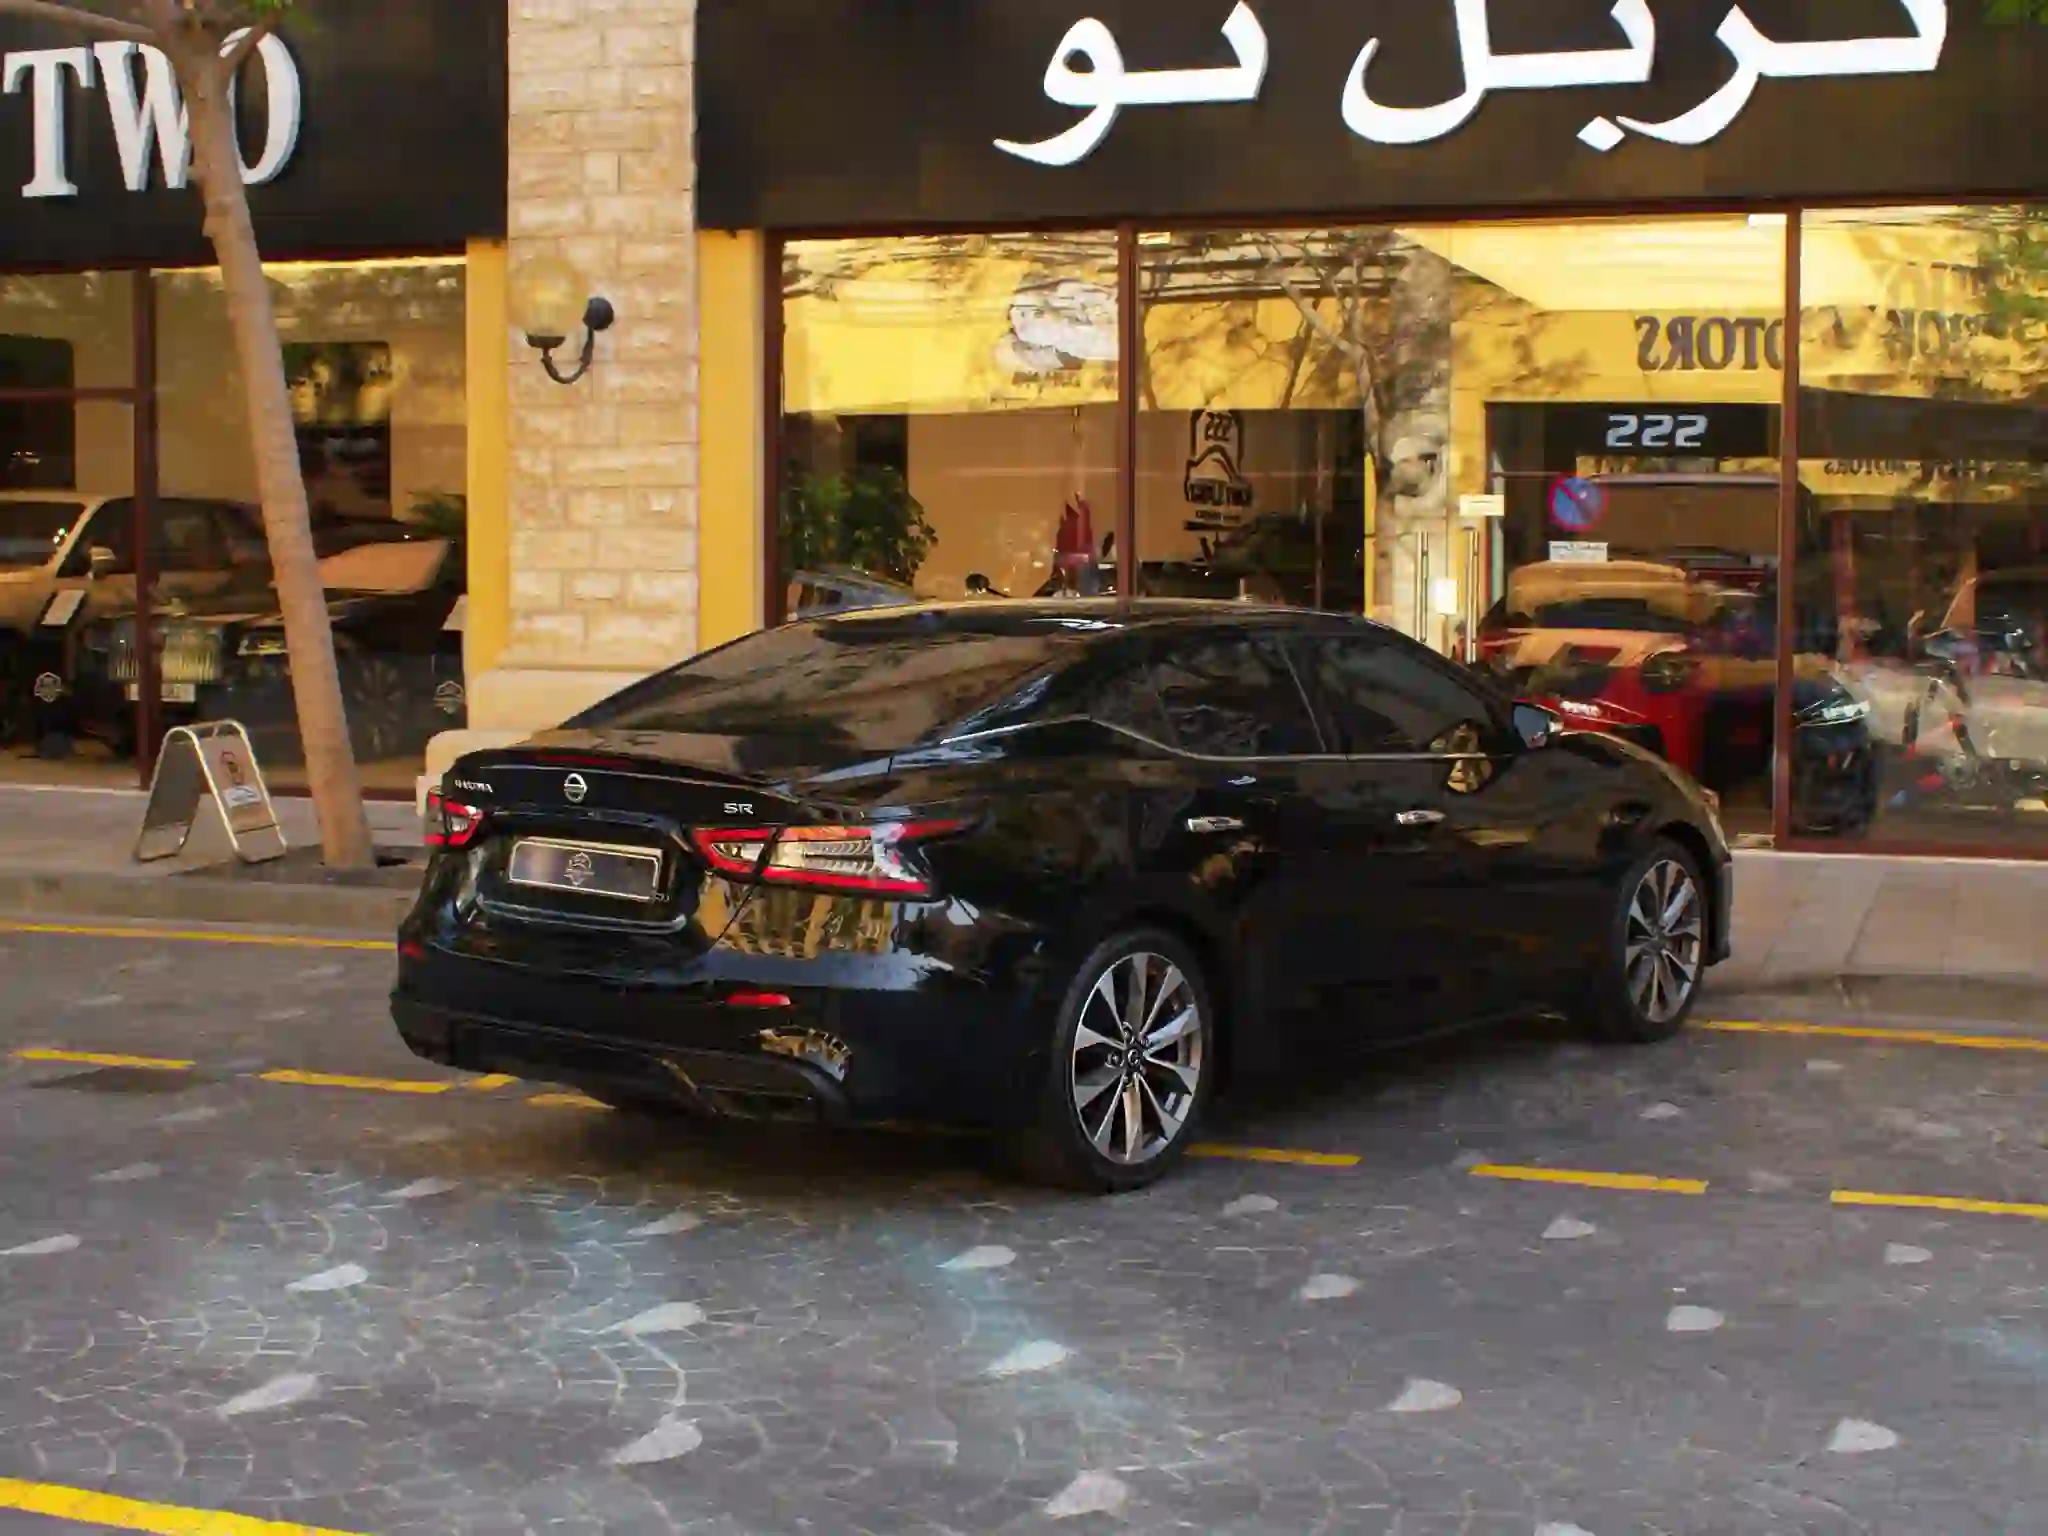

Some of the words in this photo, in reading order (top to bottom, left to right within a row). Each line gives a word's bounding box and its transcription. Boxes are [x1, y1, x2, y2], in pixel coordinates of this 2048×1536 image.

[4, 28, 300, 196] TWO
[1606, 414, 1708, 447] 222
[723, 802, 754, 815] SR
